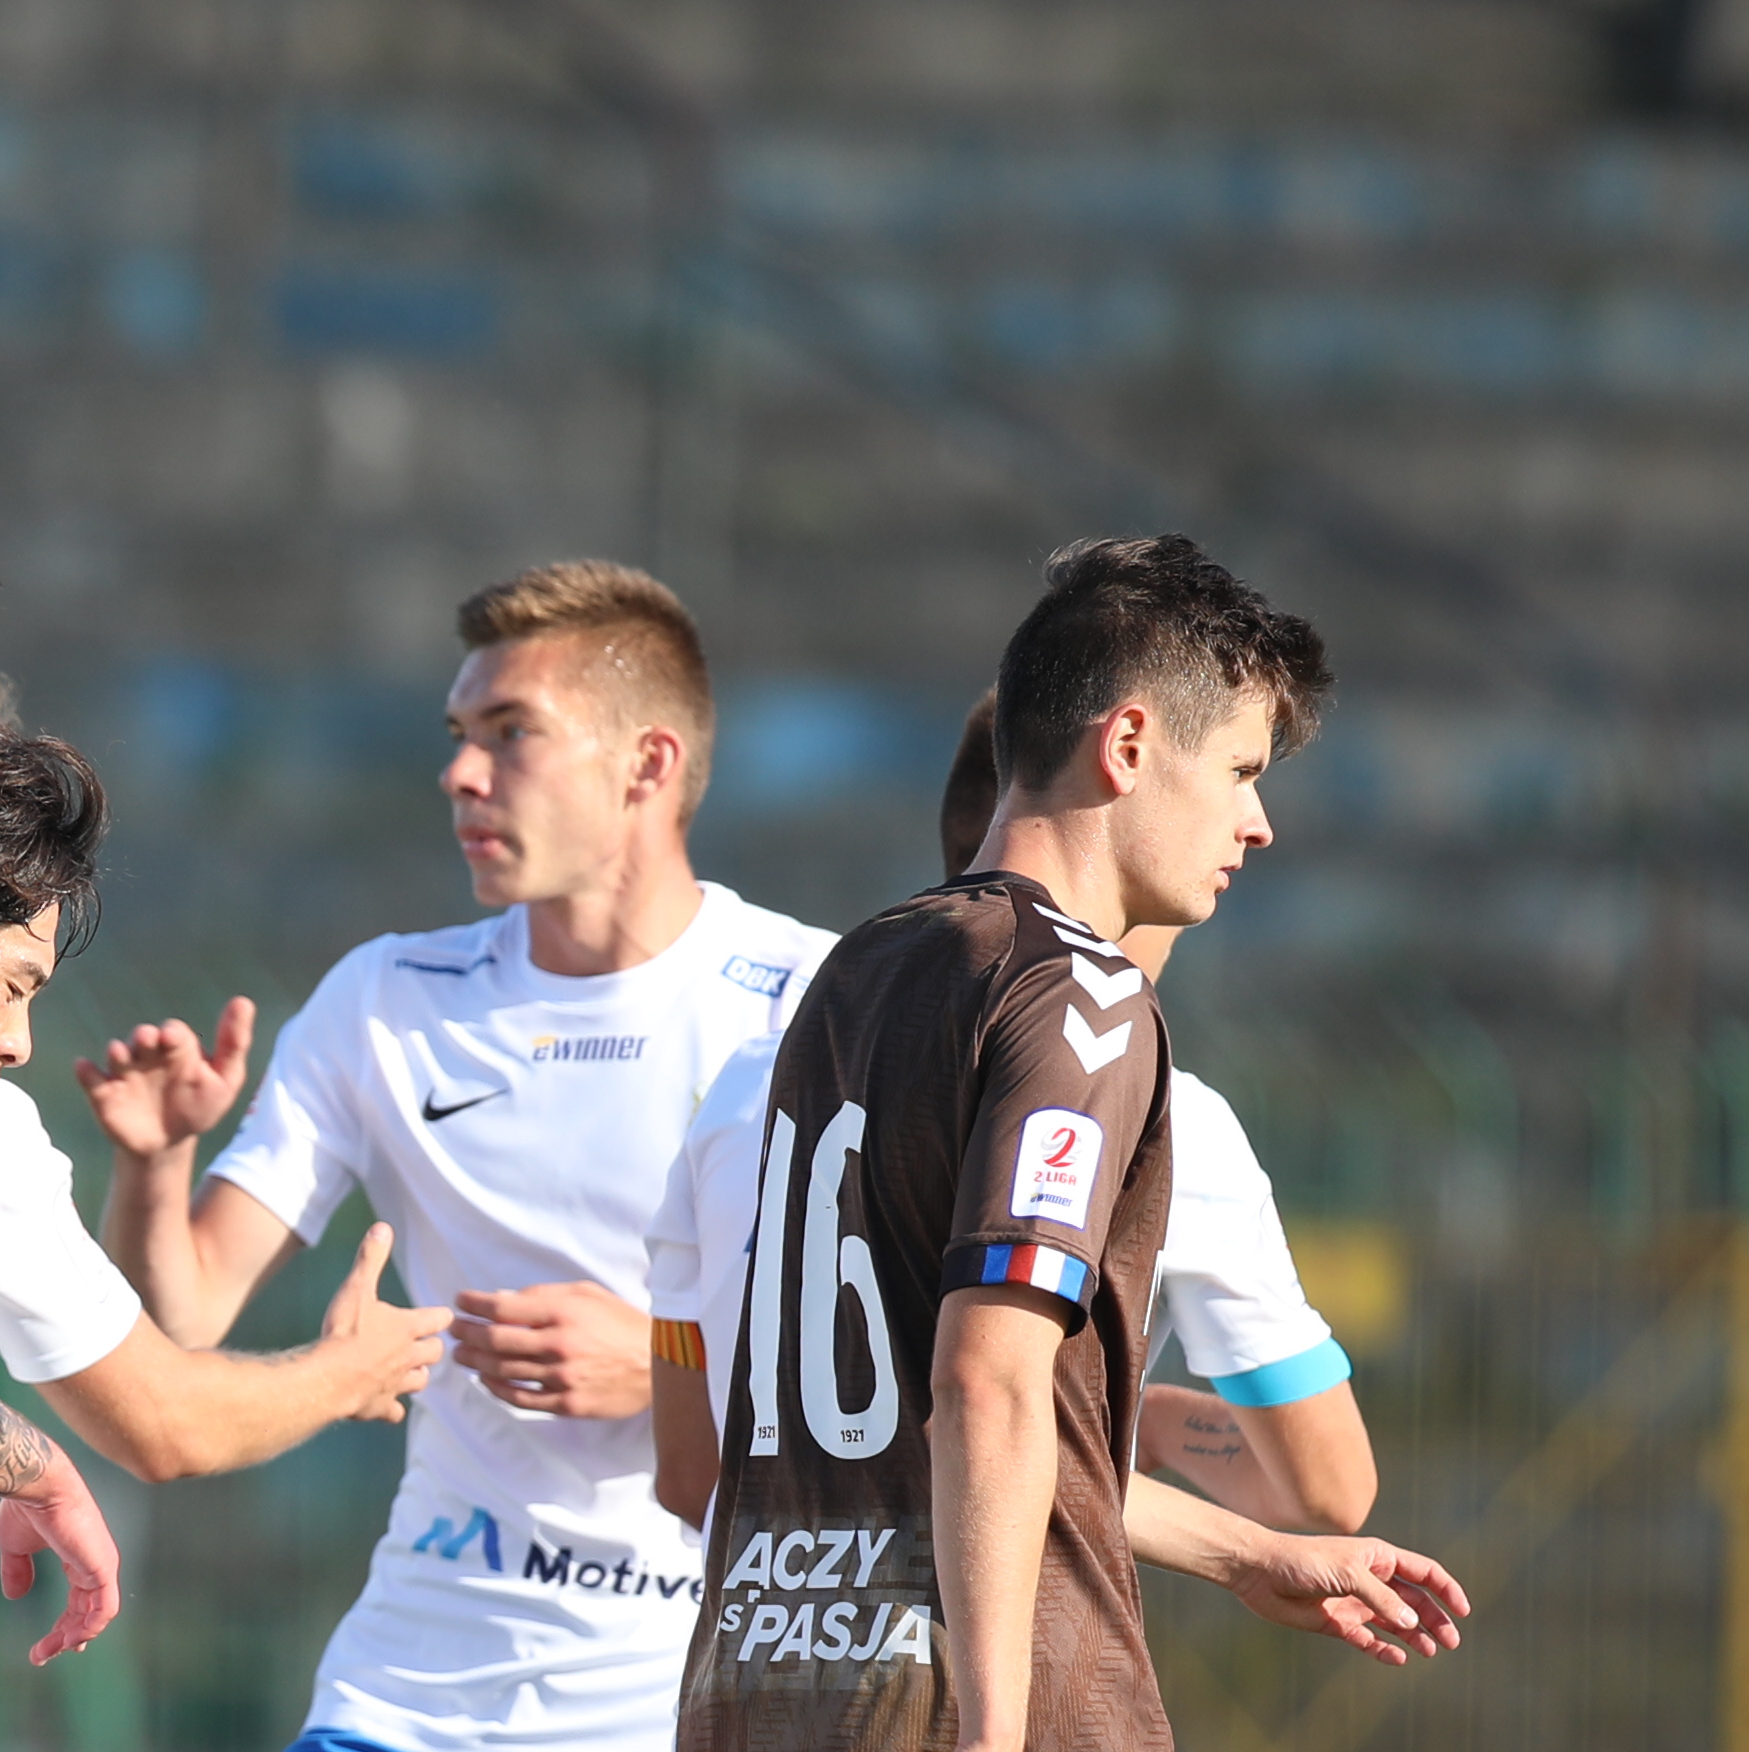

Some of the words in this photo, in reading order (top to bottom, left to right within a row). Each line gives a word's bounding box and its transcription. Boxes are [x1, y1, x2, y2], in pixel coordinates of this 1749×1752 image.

[731, 957, 789, 995] DBK
[1046, 1170, 1078, 1187] LIGA
[748, 1100, 900, 1459] 16
[757, 1425, 776, 1440] 1921
[839, 1428, 865, 1443] 1921
[736, 1601, 932, 1665] PASJA
